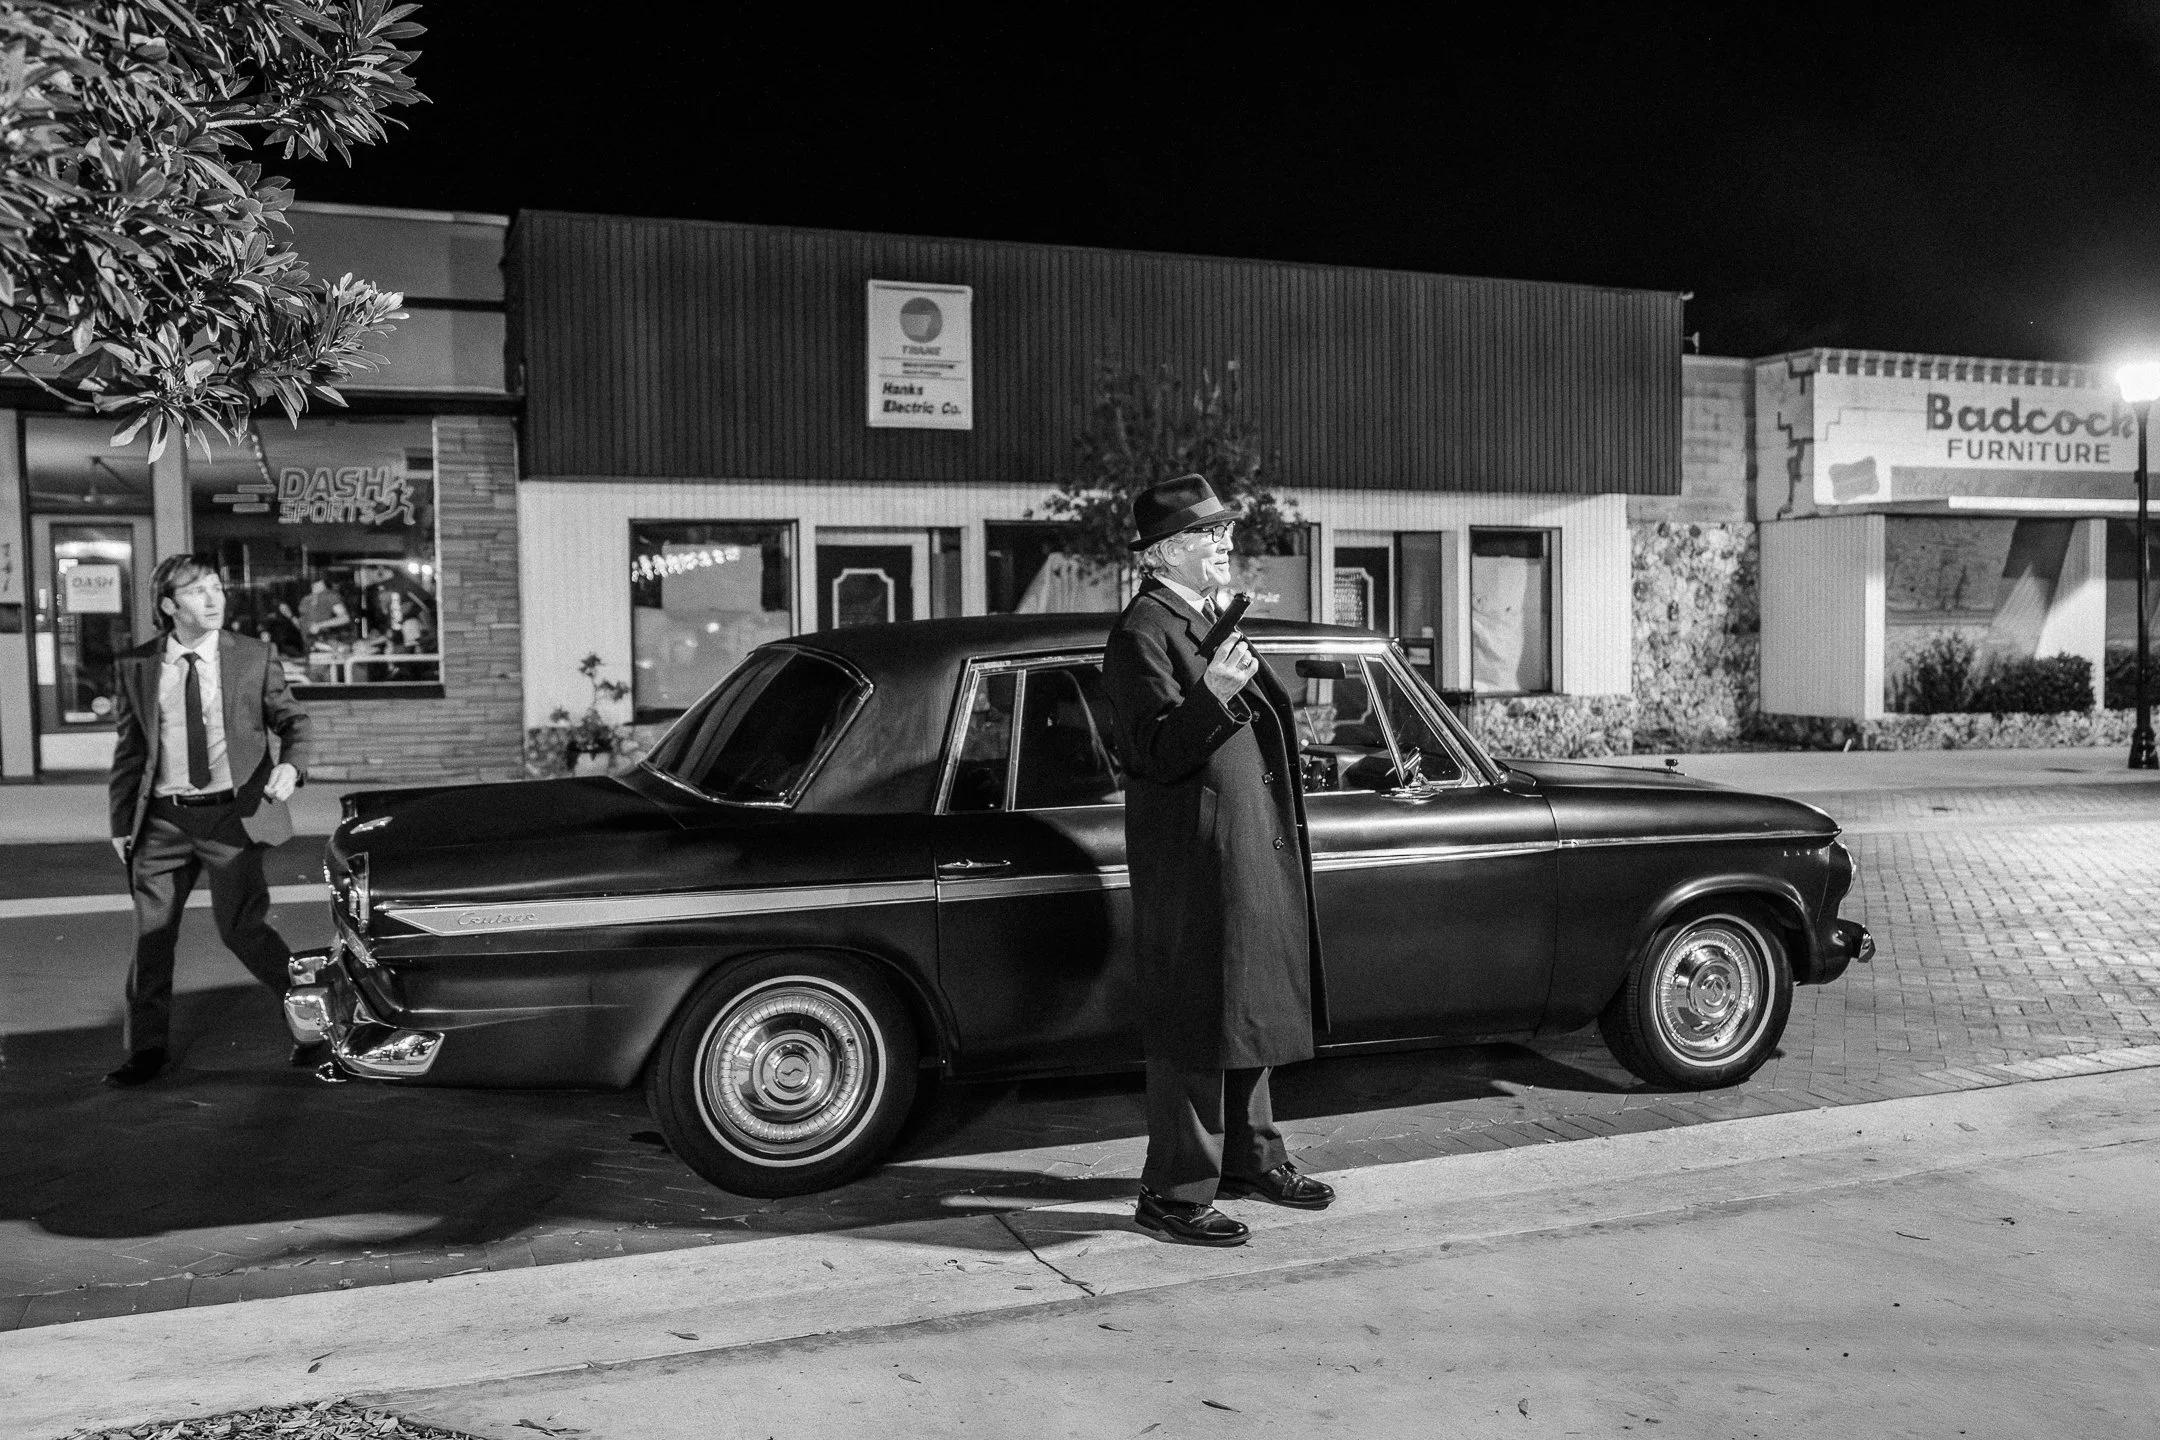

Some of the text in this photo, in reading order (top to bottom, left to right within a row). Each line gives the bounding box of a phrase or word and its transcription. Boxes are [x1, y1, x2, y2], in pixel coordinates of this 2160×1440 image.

[882, 400, 962, 415] Electric Co.
[1926, 393, 2137, 439] Badcock
[1947, 438, 2112, 464] FURNITURE
[278, 466, 391, 502] DASH
